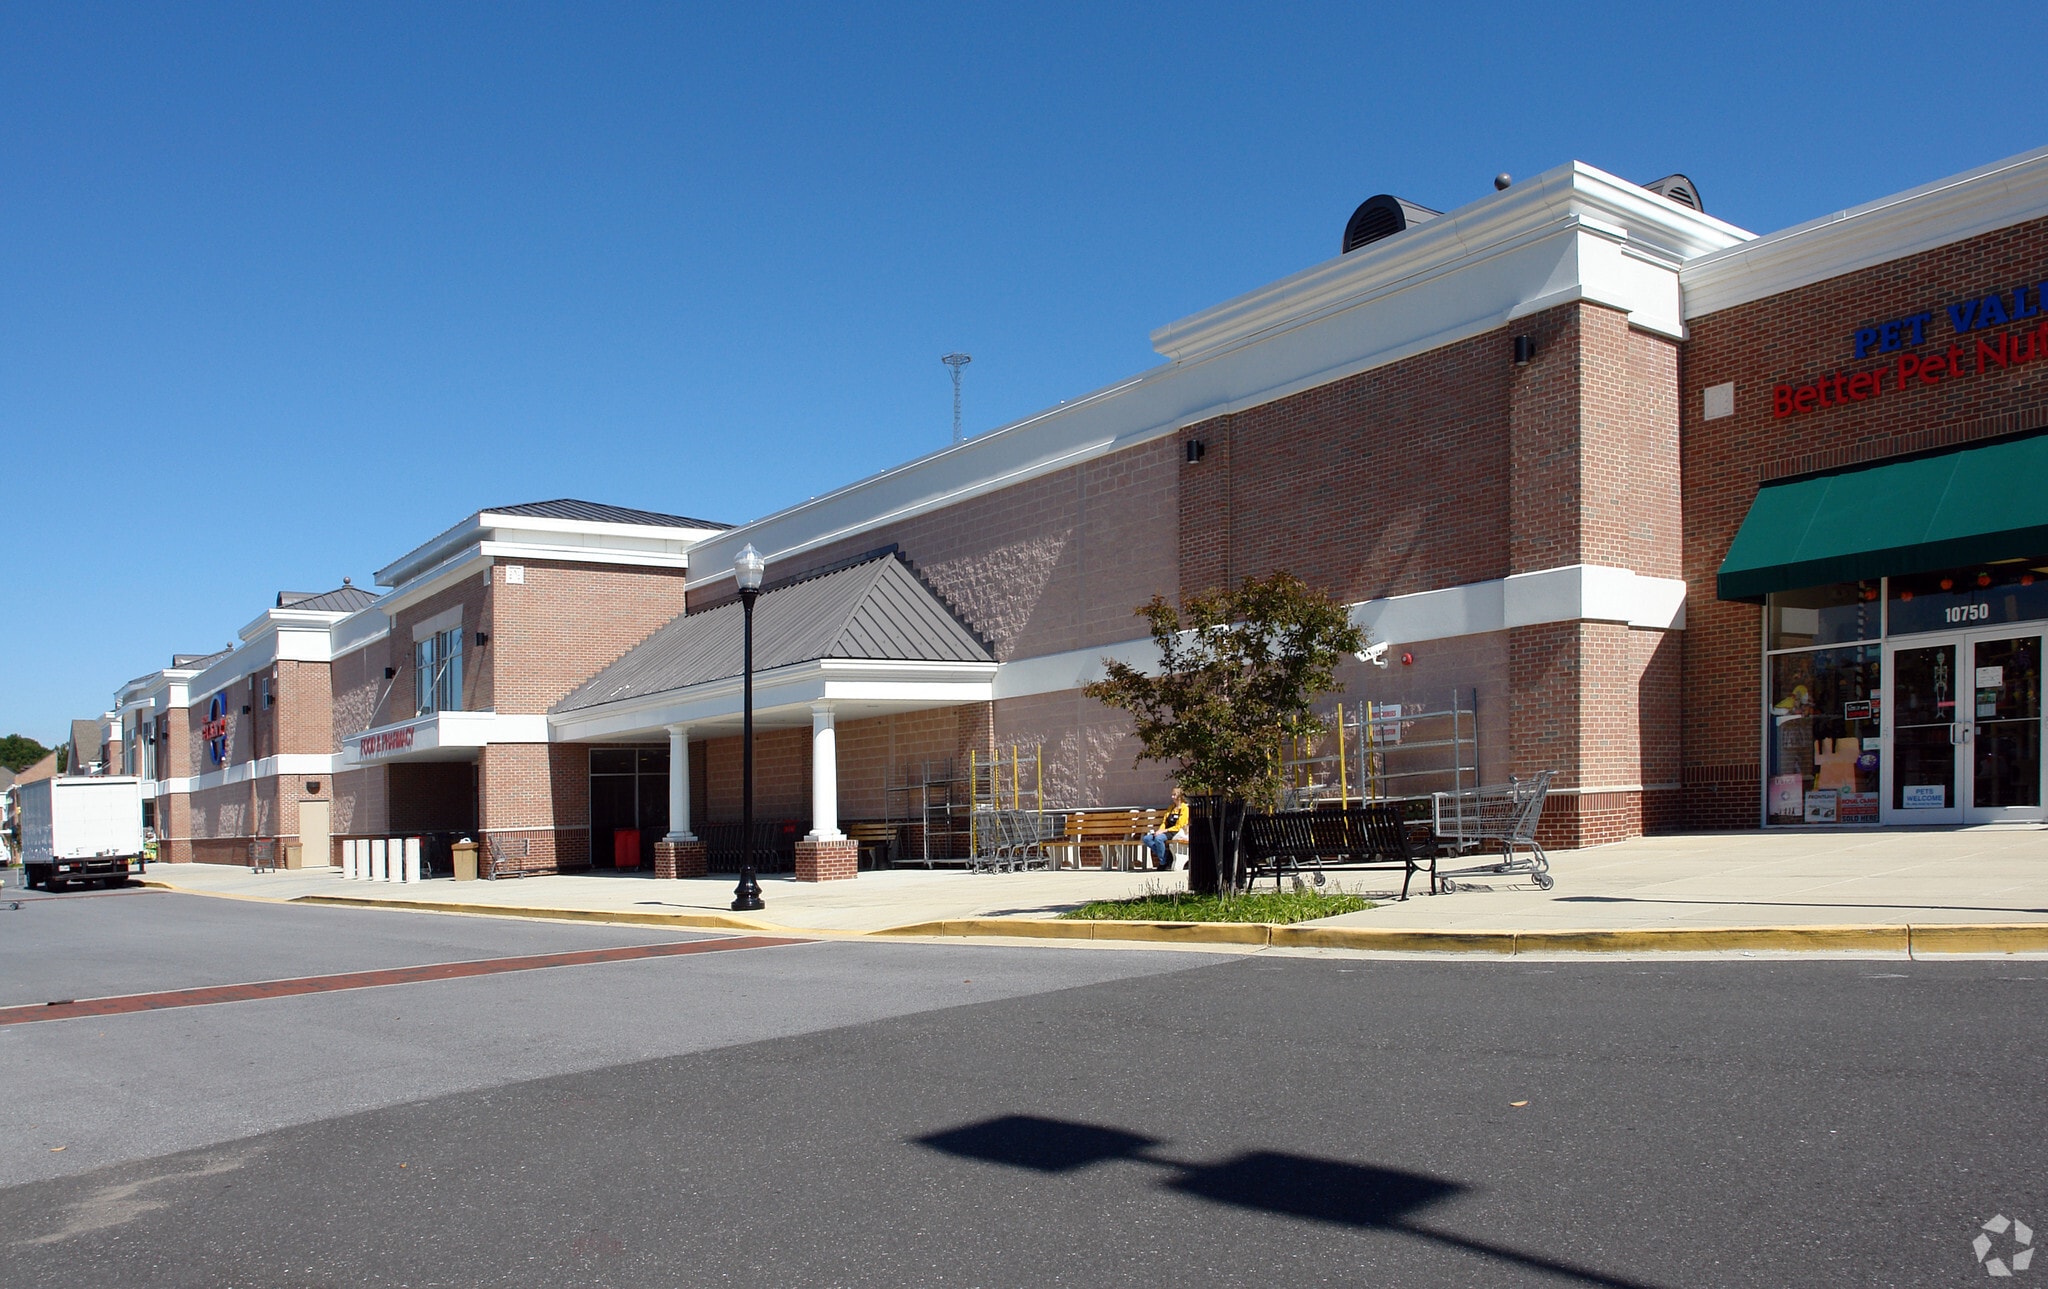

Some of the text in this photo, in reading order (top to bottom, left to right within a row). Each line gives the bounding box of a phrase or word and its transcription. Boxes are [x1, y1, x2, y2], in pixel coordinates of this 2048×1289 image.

[1854, 312, 1931, 360] PET
[1773, 367, 1888, 418] Better
[1897, 343, 1965, 391] Pet
[1945, 603, 1989, 623] 10750
